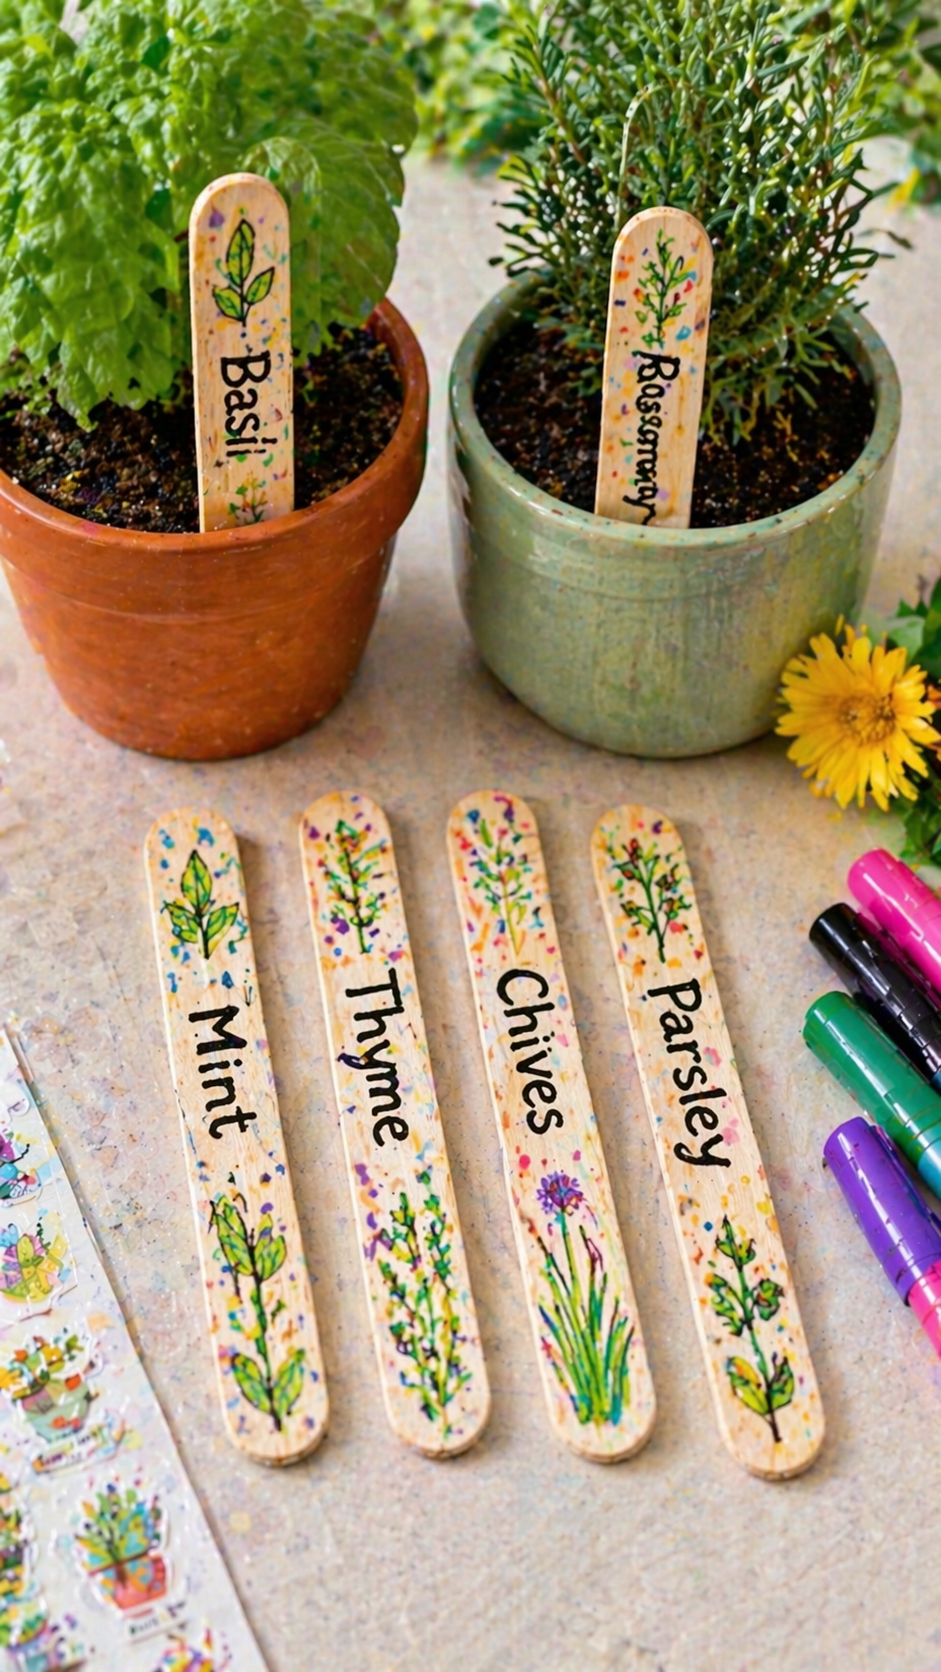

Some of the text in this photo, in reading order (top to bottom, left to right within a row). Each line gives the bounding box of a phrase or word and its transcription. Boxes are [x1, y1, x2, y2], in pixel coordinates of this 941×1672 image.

[188, 1005, 257, 1139] Mint
[337, 967, 409, 1147] Thyme
[496, 968, 564, 1135] Chives
[647, 978, 731, 1168] Parsley
